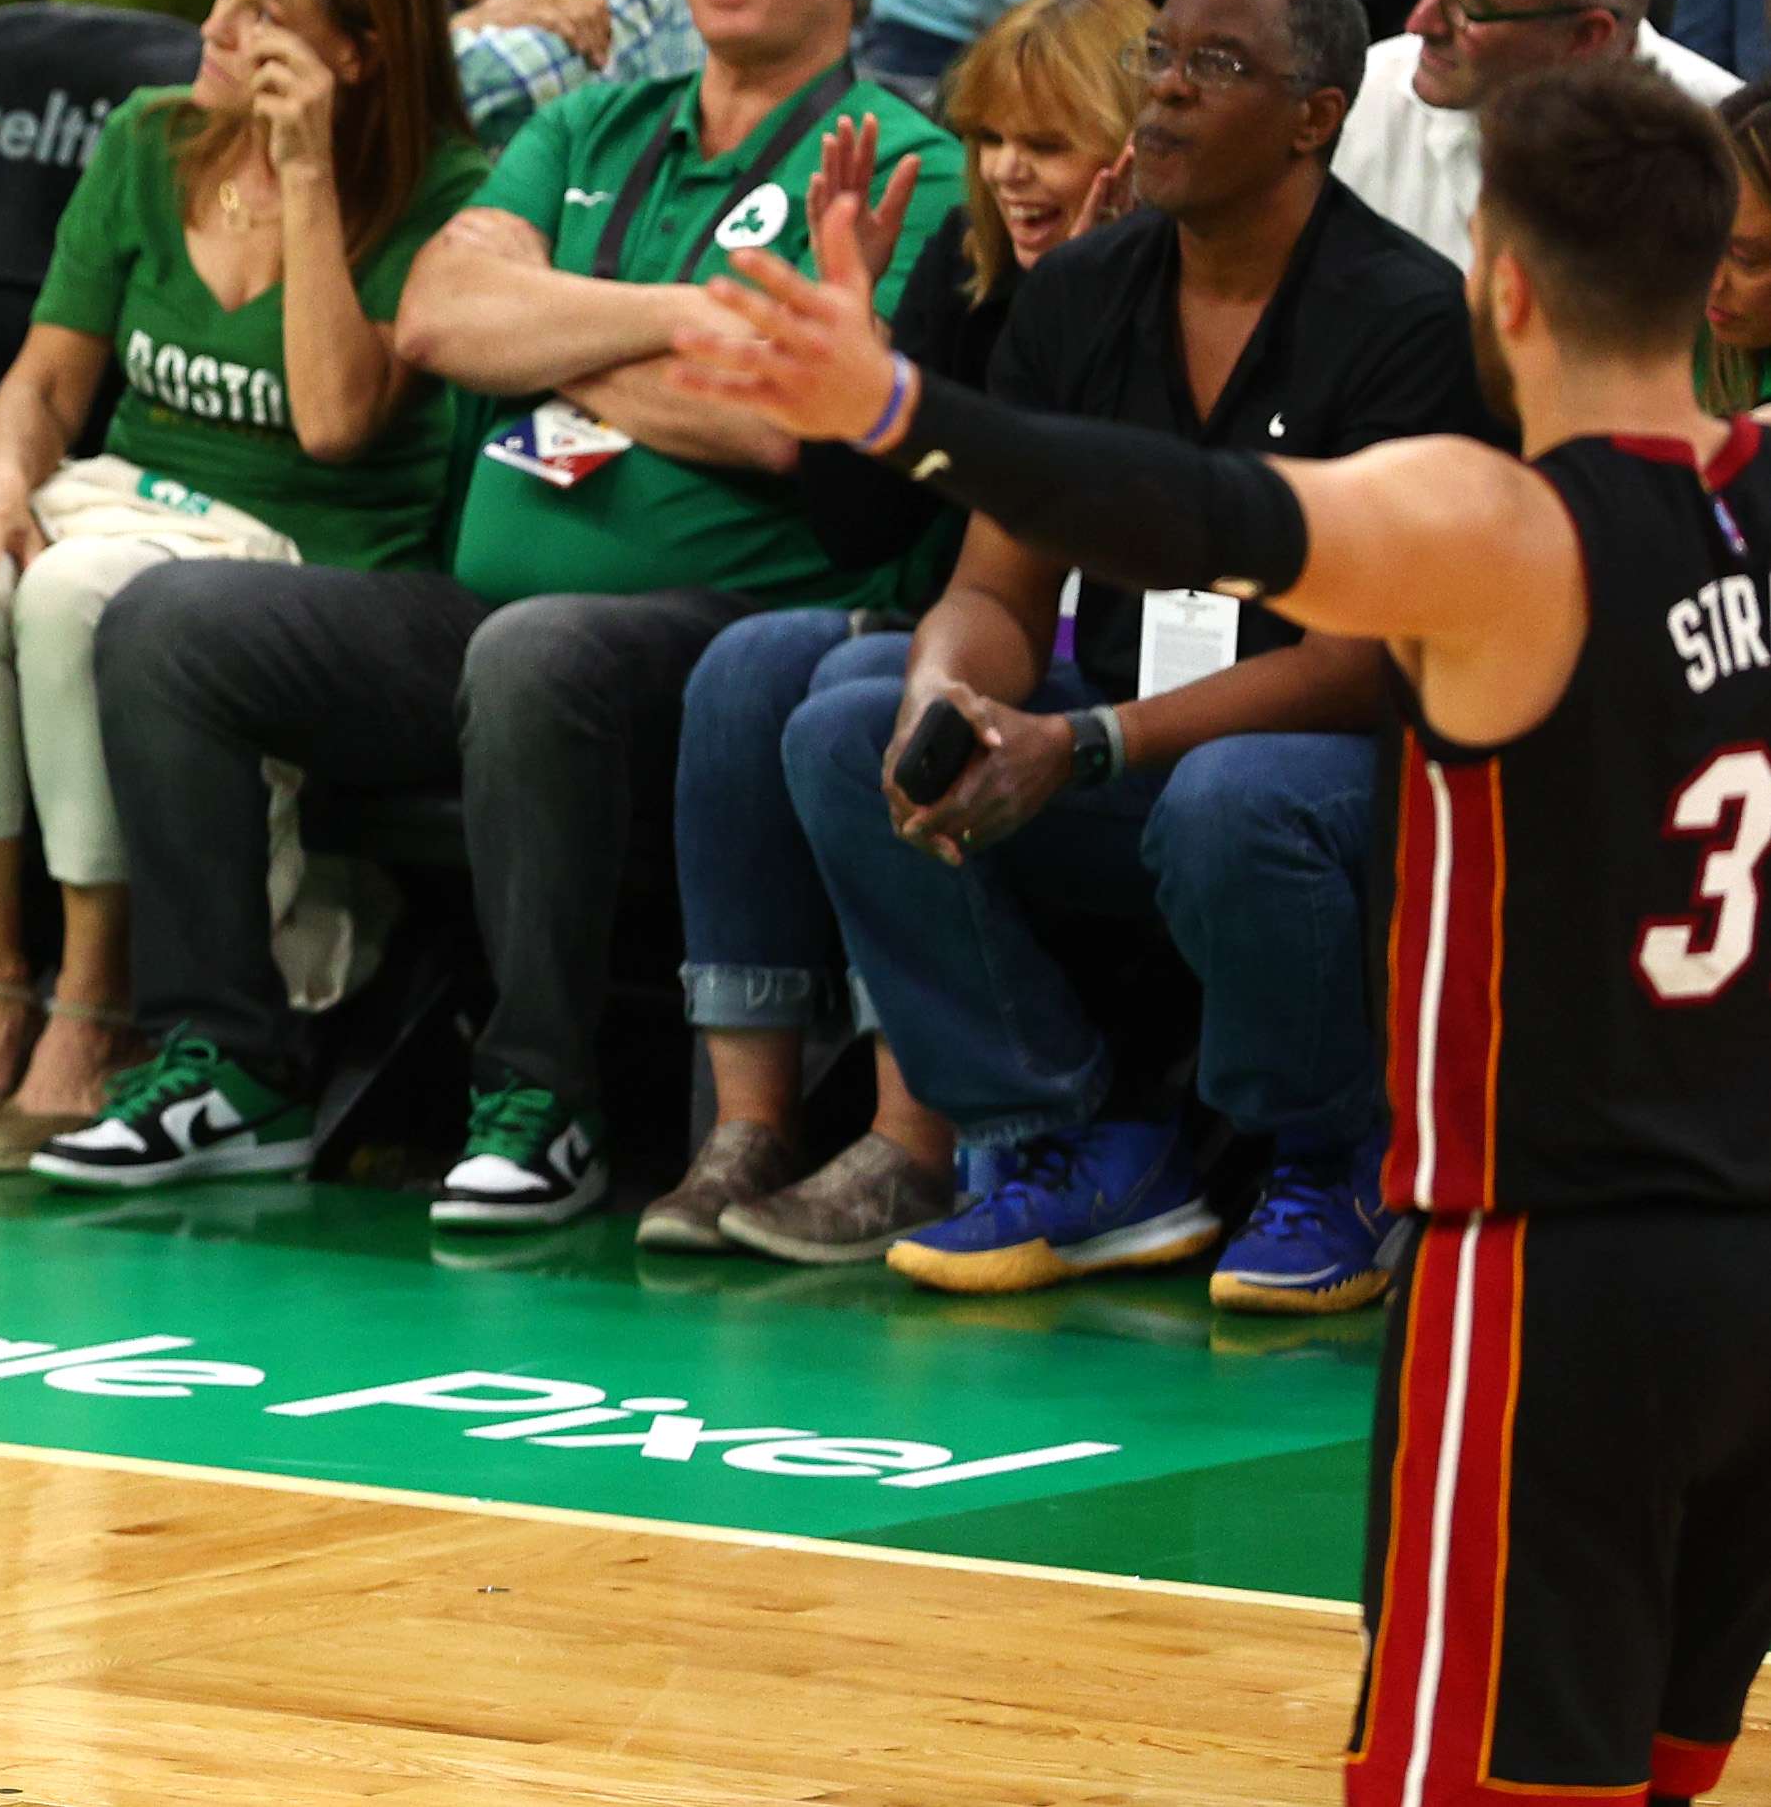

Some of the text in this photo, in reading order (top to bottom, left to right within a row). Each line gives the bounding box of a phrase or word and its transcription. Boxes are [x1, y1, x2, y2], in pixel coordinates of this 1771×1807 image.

[125, 328, 285, 426] BOSTO
[1667, 572, 1771, 695] STR
[264, 1370, 1122, 1489] Pixel
